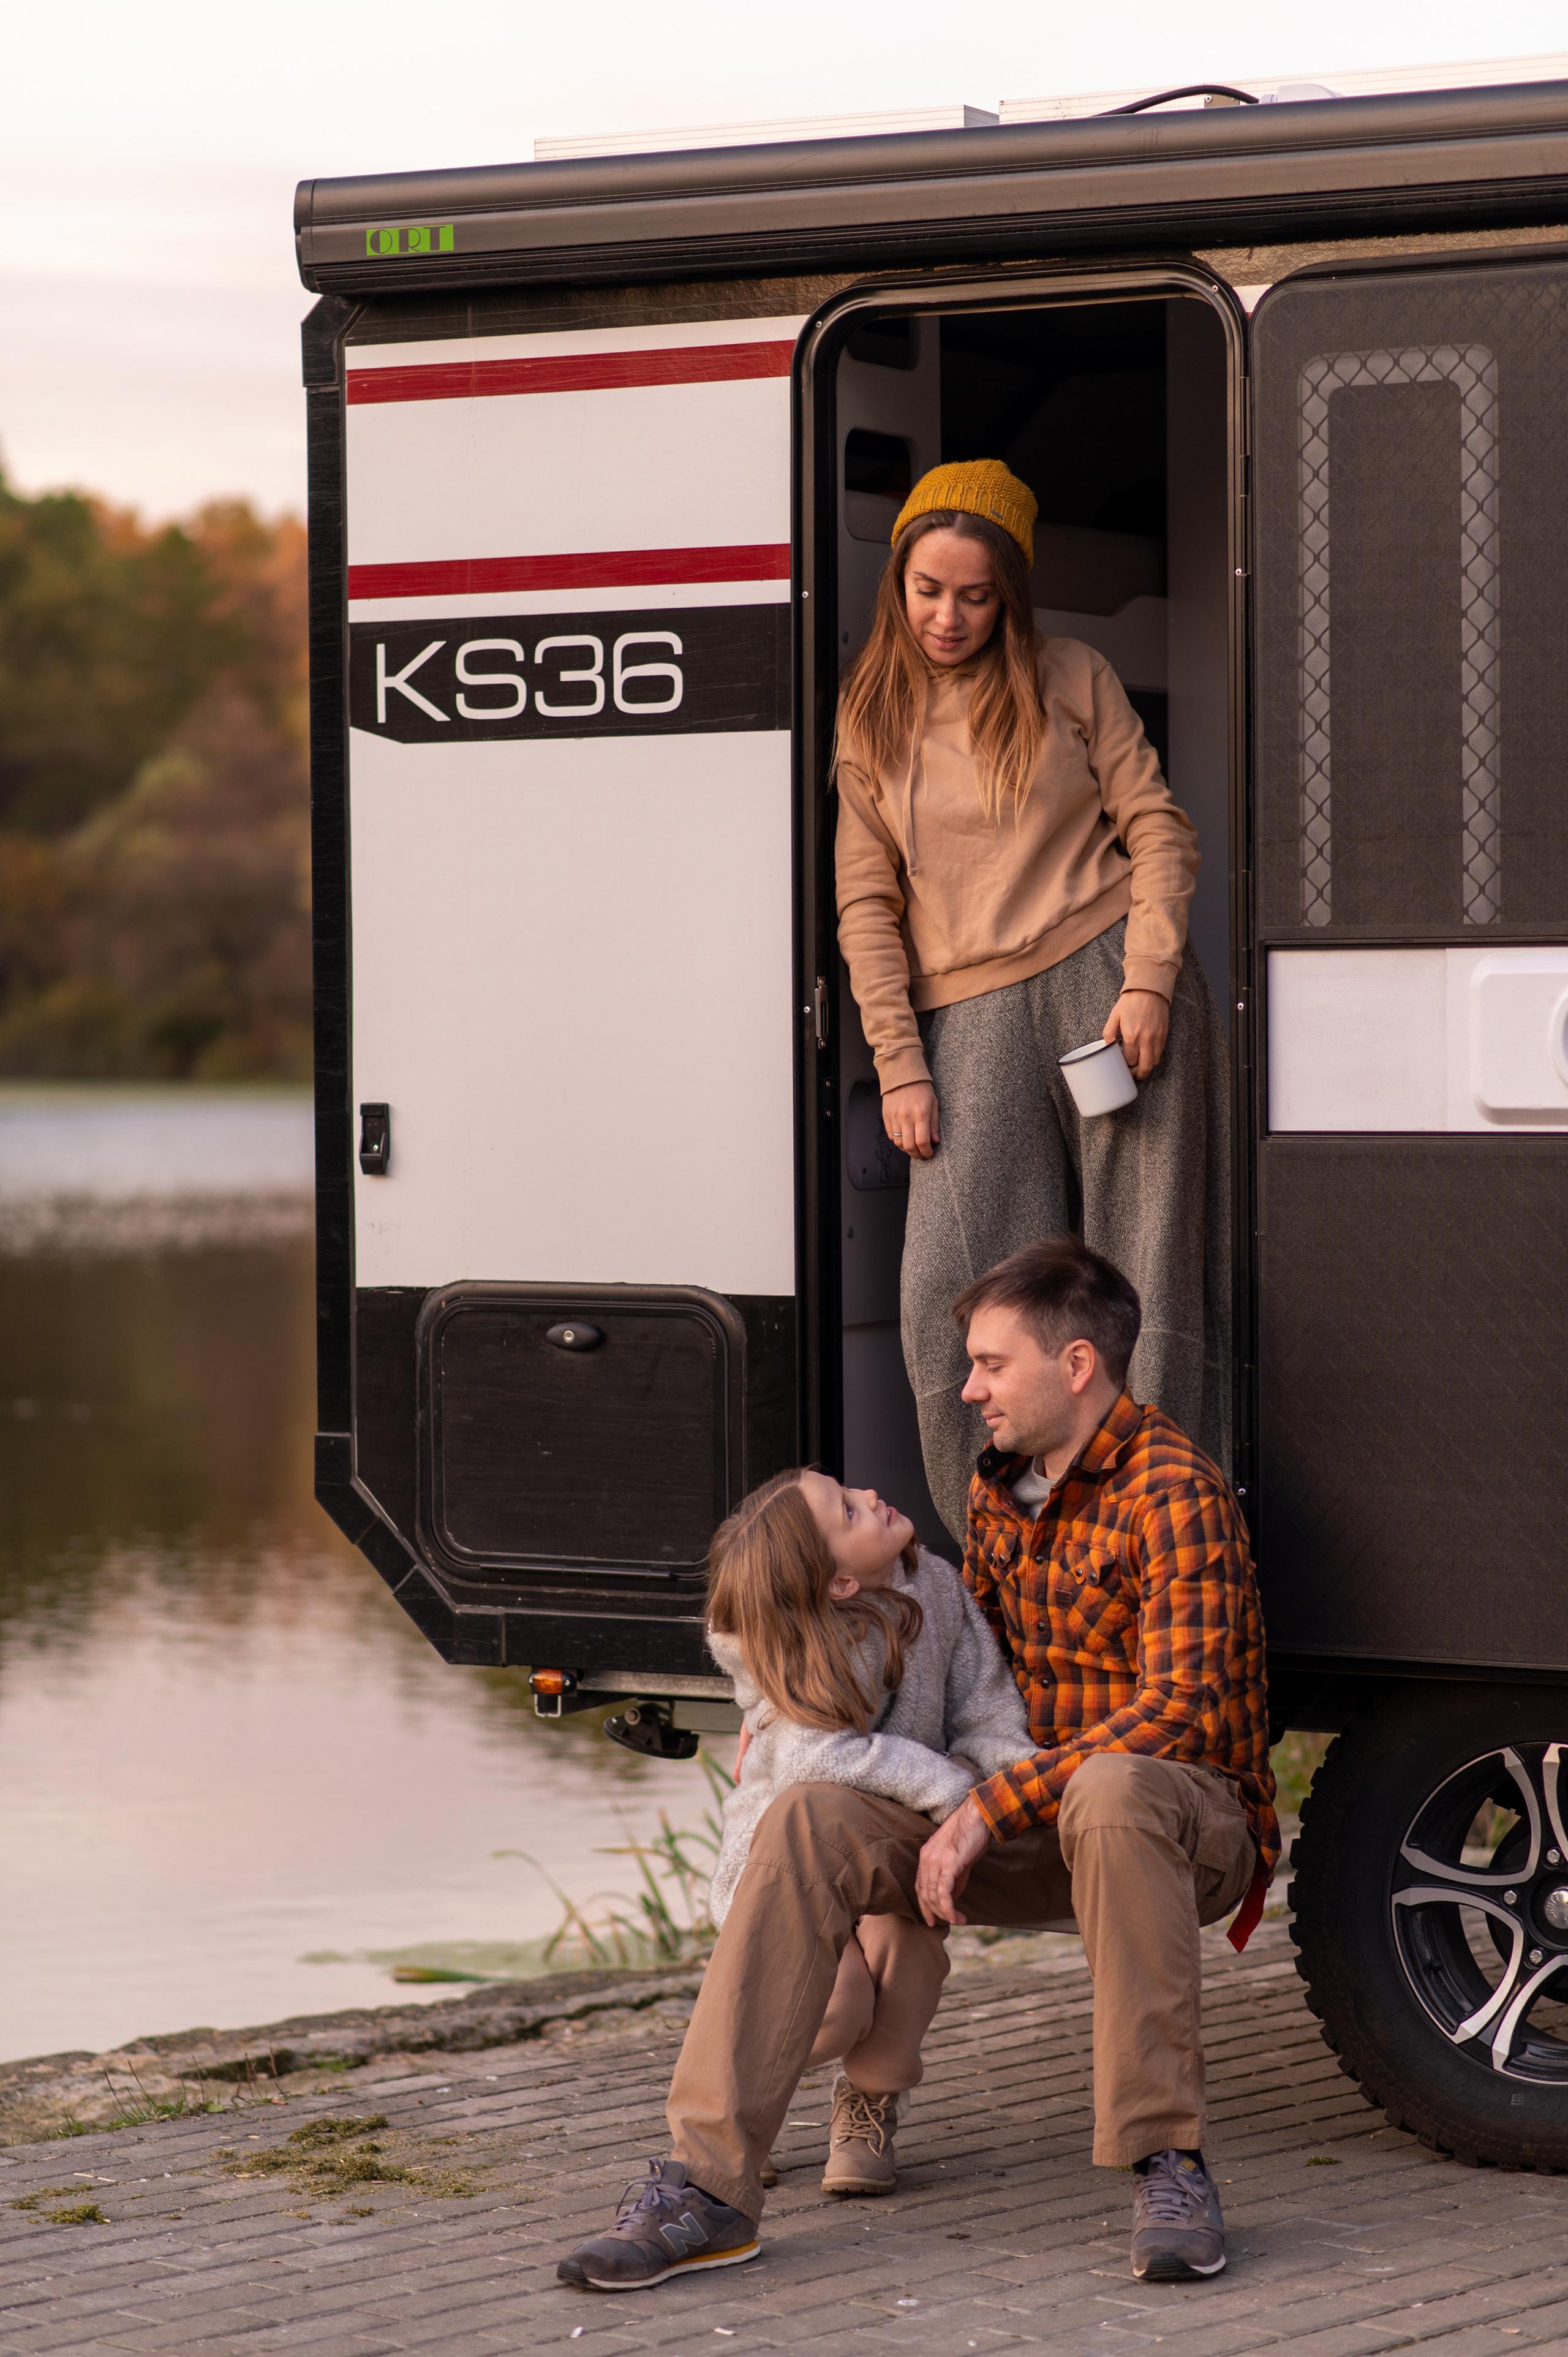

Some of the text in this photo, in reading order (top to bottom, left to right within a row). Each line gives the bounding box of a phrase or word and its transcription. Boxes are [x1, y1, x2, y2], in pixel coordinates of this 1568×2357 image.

[369, 226, 446, 254] ORT
[375, 631, 684, 724] KS36
[658, 2212, 709, 2257] N
